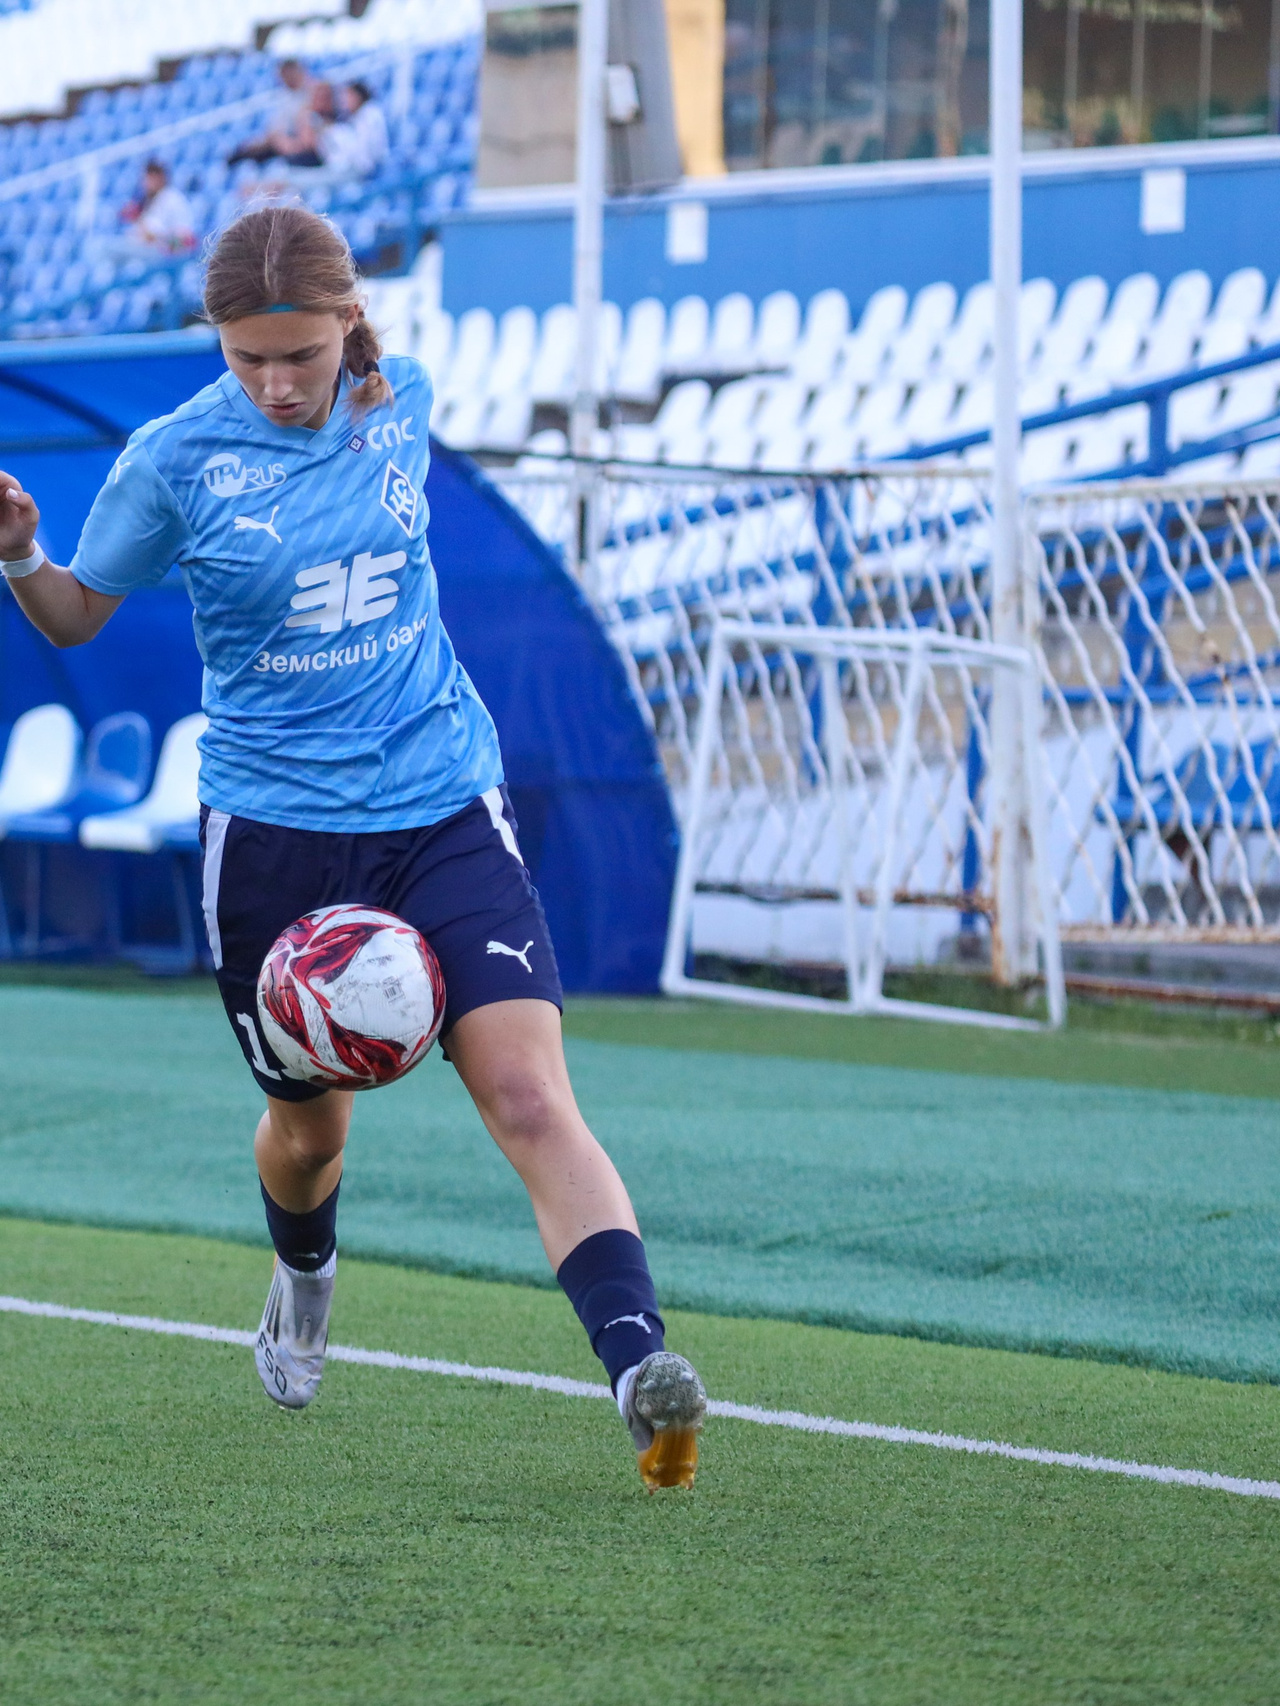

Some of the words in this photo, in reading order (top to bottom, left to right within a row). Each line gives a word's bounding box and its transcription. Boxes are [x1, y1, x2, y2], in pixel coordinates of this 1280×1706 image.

[252, 633, 379, 674] Земский
[235, 1011, 298, 1081] 1
[257, 1330, 288, 1396] F50
